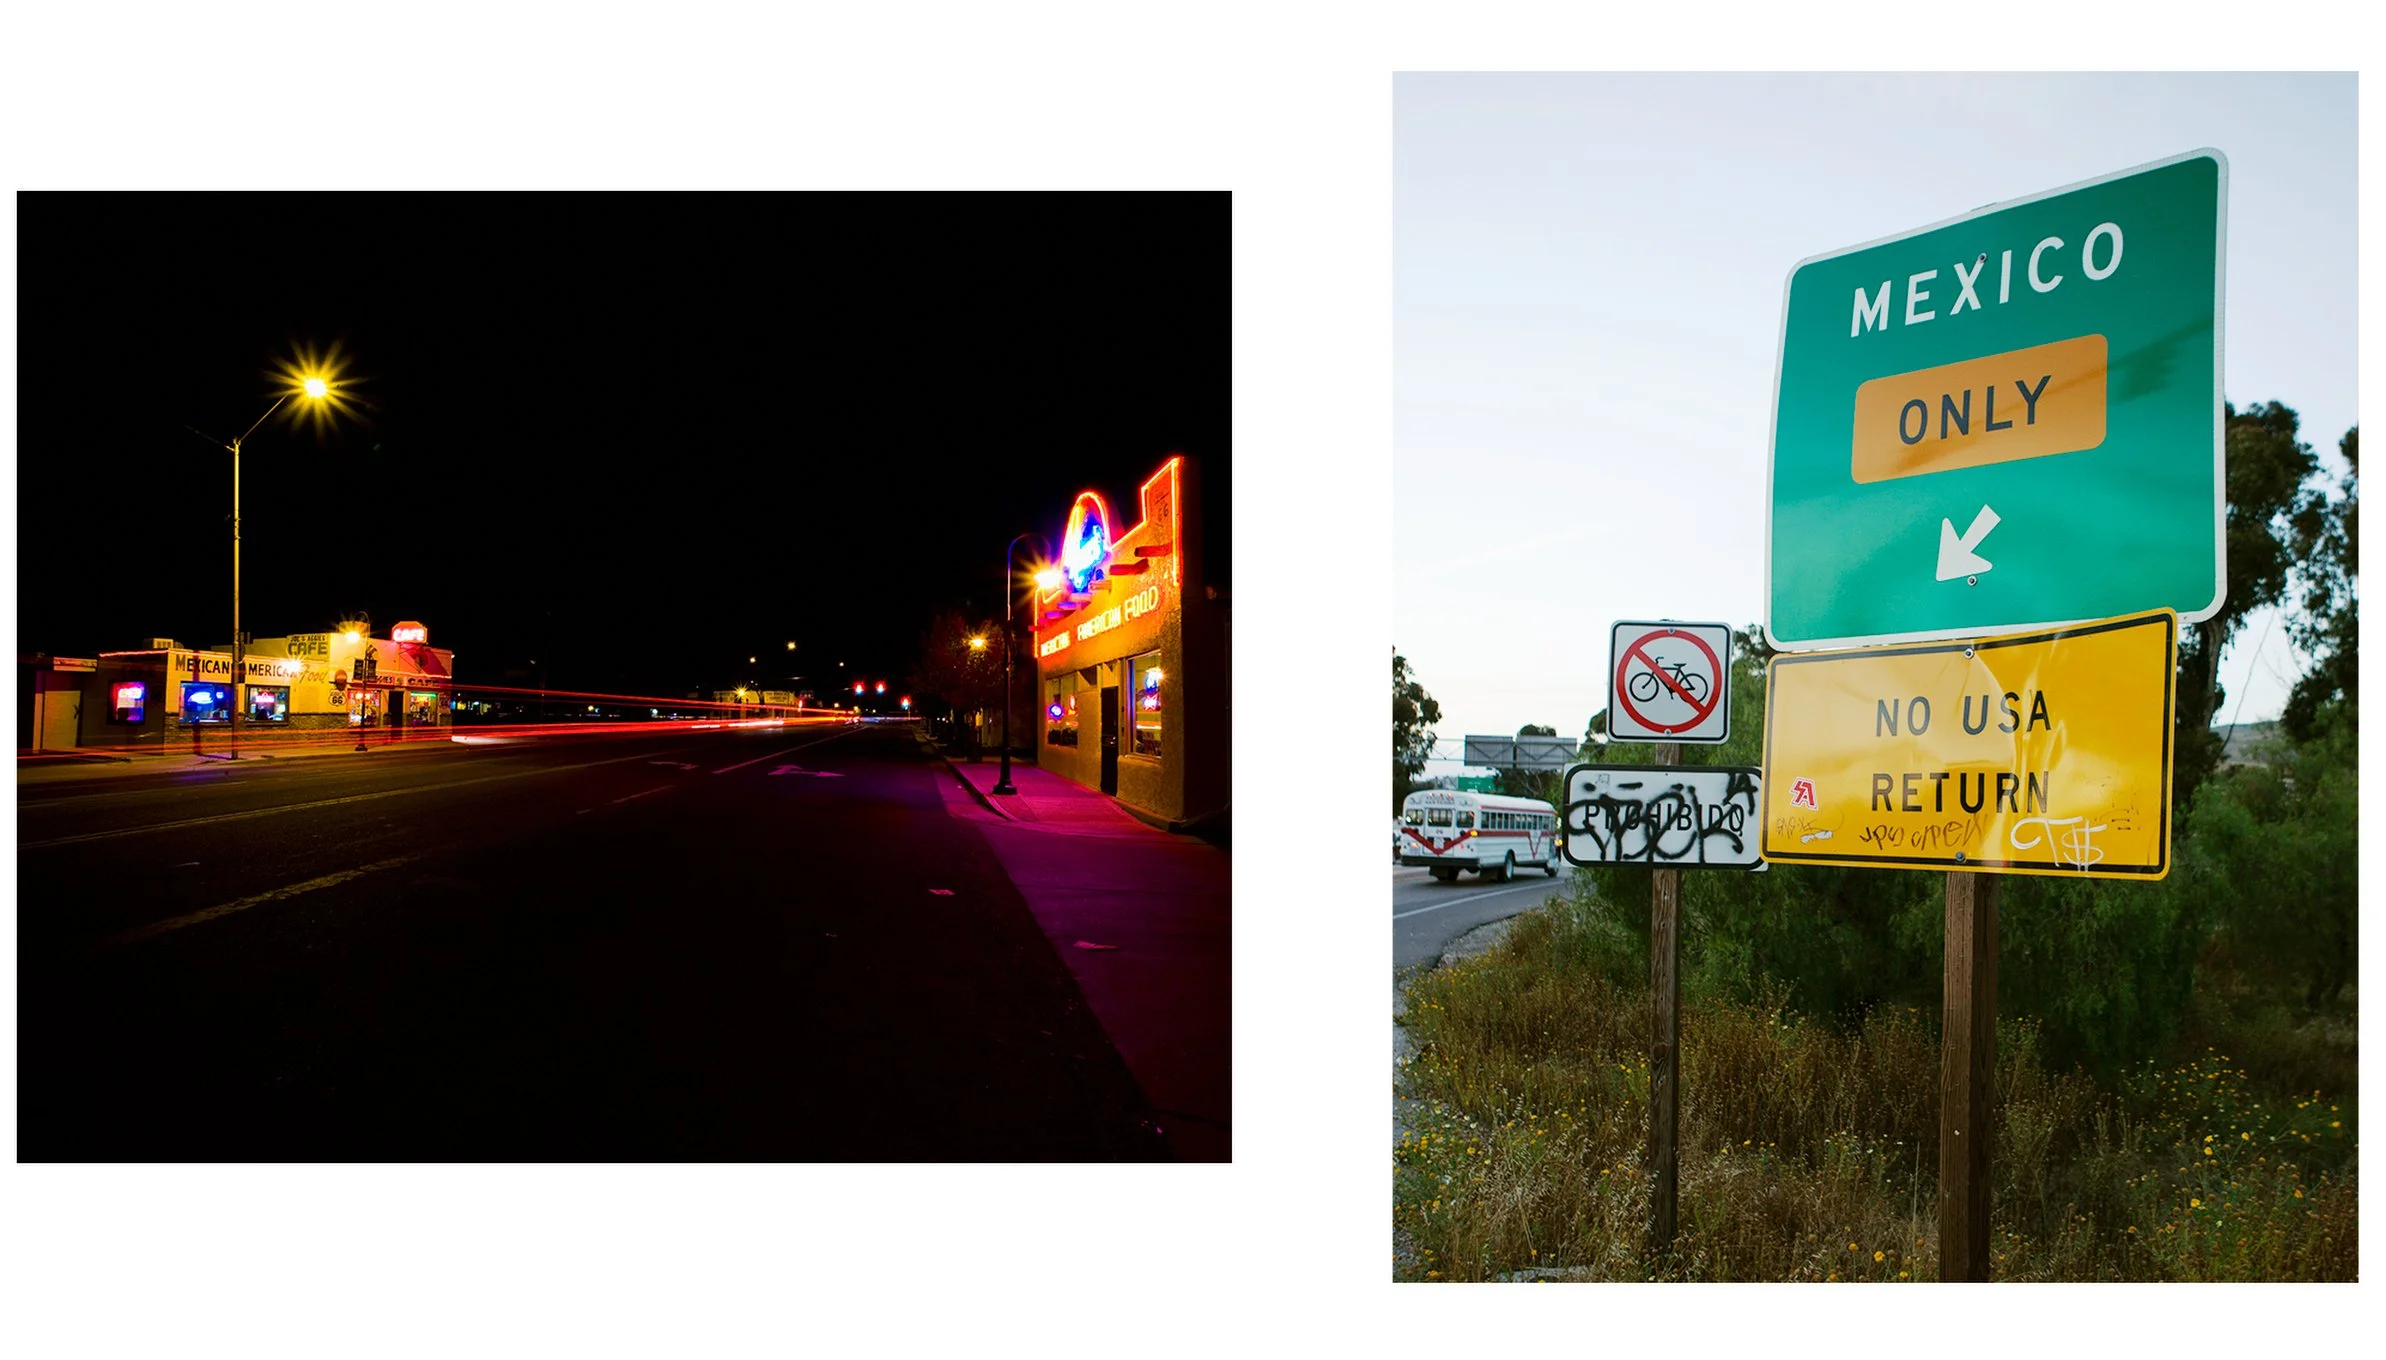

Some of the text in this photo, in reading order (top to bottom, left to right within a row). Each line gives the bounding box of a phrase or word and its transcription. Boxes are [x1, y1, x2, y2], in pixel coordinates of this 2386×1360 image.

[1851, 222, 2124, 338] MEXICO
[1899, 374, 2052, 445] ONLY
[1124, 585, 1159, 621] FOOD
[288, 642, 328, 655] CAFE
[393, 627, 425, 643] CAFE
[175, 654, 230, 674] MEXICAN
[332, 696, 344, 704] 66
[1876, 690, 2051, 737] NO USA
[1872, 771, 2049, 814] RETURN
